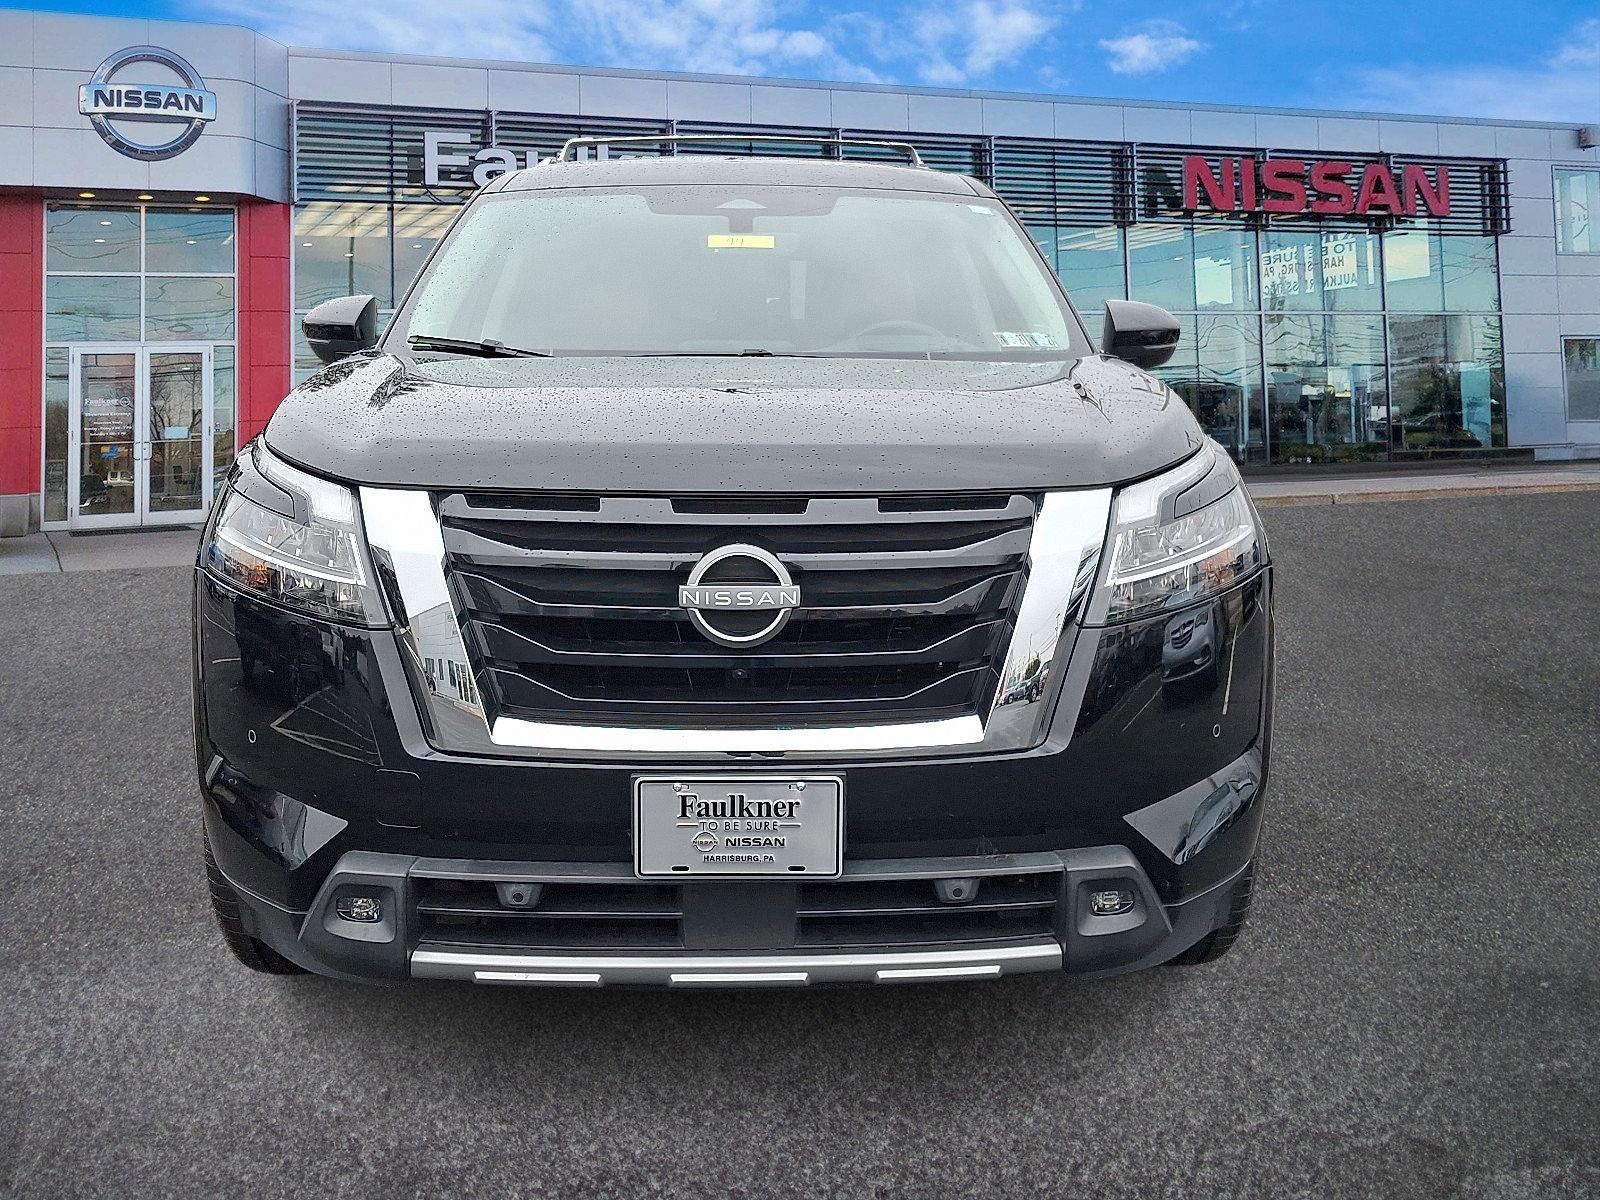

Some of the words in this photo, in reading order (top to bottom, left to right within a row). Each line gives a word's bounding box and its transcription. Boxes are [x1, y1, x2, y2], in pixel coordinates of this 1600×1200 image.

[94, 89, 203, 113] NISSAN
[1182, 155, 1450, 216] NISSAN
[682, 590, 797, 606] NISSAN
[677, 794, 800, 818] Faulkner
[700, 821, 718, 831] TO
[724, 821, 739, 831] BE
[746, 821, 778, 831] SURE
[725, 837, 785, 847] NISSAN
[703, 855, 762, 863] HARRISBURG,
